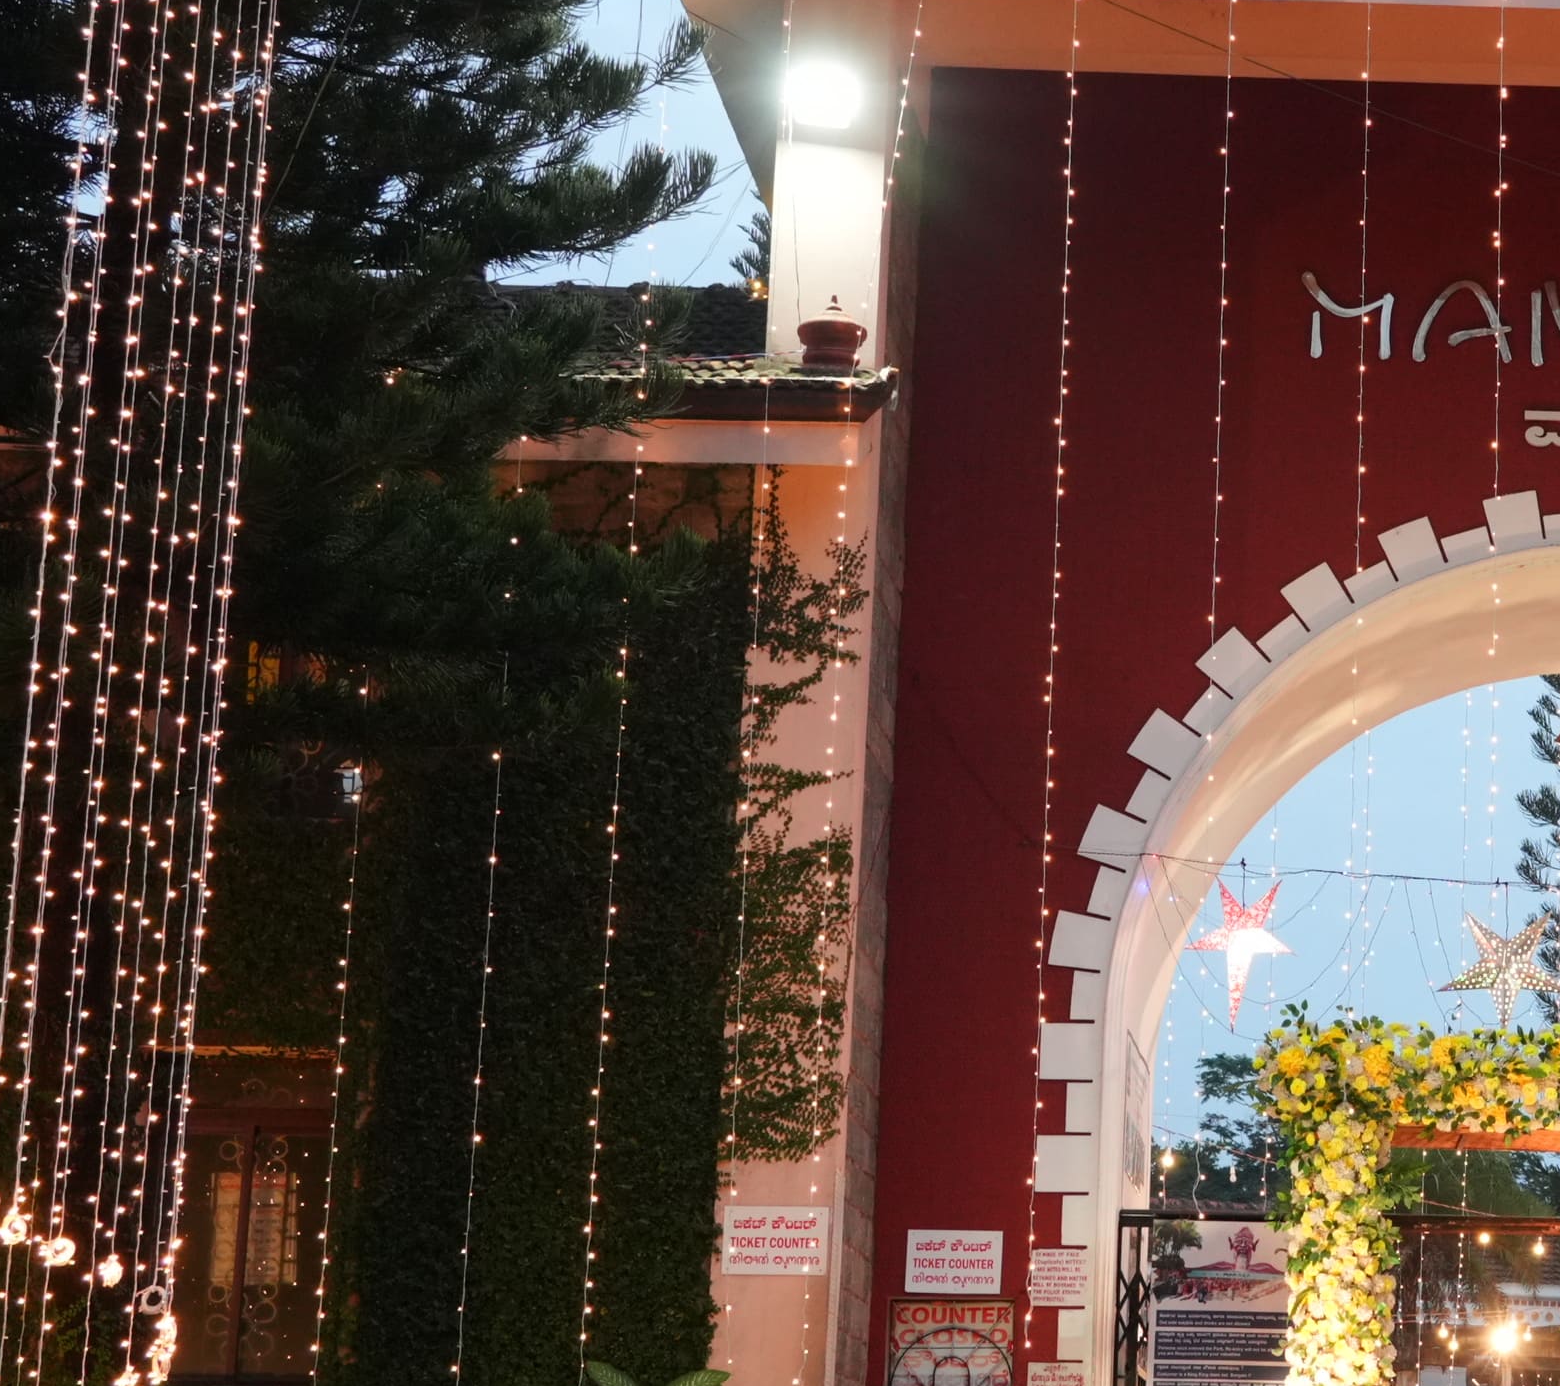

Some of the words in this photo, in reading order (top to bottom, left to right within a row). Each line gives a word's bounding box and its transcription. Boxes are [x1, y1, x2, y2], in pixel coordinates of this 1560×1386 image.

[730, 1237, 767, 1248] TICKET
[769, 1237, 819, 1248] COUNTER
[913, 1258, 946, 1269] TICKET
[948, 1259, 994, 1269] COUNTER
[897, 1306, 1011, 1324] COUNTER
[900, 1328, 1008, 1344] CLOSED
